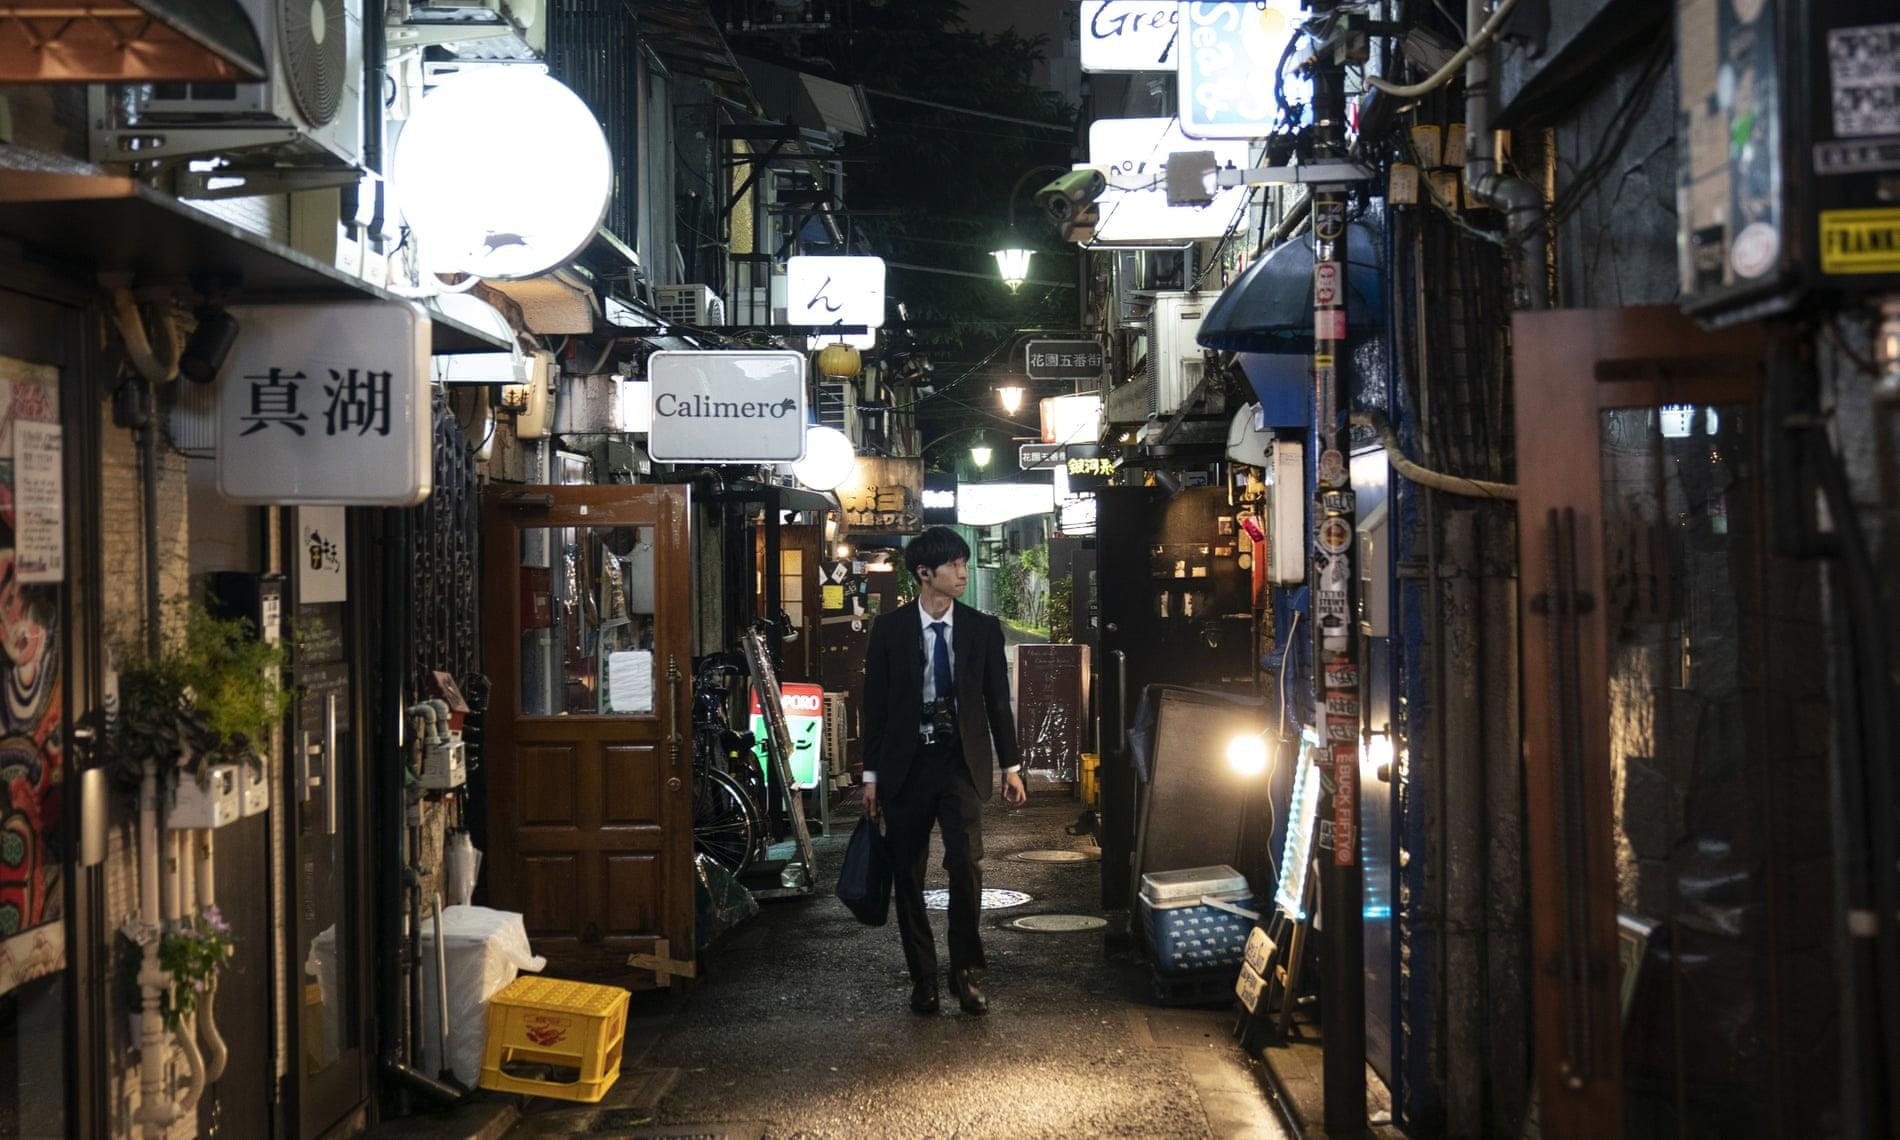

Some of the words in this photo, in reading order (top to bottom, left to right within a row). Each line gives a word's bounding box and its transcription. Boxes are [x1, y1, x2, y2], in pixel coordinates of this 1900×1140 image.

[1031, 353, 1101, 367] 花園五番街
[239, 366, 393, 437] 真湖
[655, 393, 788, 419] Calimero
[1068, 458, 1113, 476] 銀河系
[1339, 765, 1353, 807] BUCK
